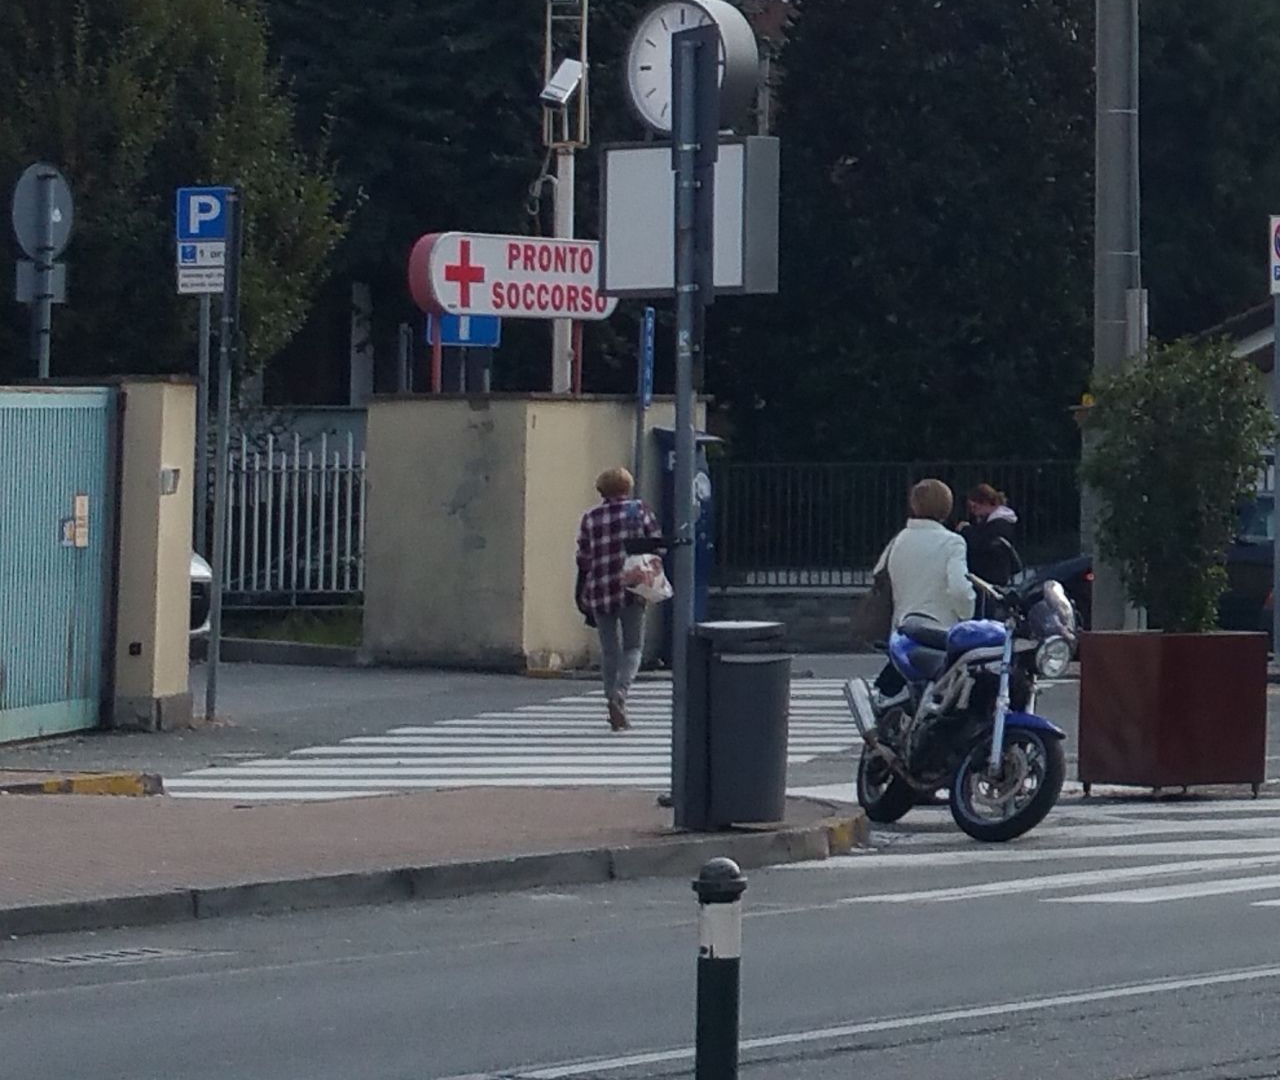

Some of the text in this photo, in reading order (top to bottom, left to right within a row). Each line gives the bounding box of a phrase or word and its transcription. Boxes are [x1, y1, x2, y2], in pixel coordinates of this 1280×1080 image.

[189, 195, 221, 234] P
[508, 243, 593, 274] PRONTO
[492, 281, 607, 313] SOCCORSO
